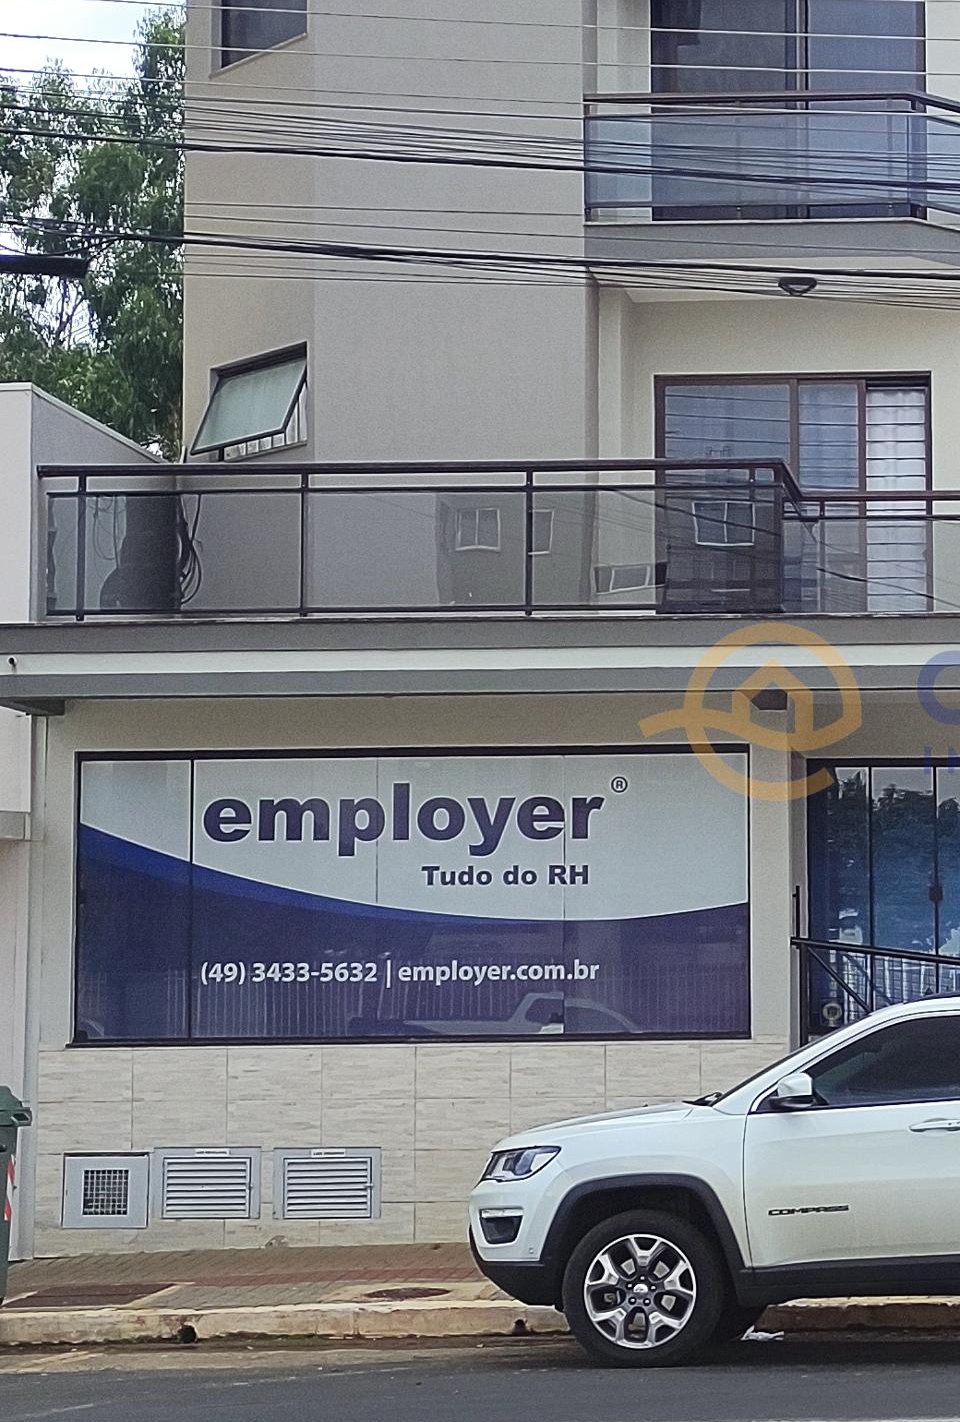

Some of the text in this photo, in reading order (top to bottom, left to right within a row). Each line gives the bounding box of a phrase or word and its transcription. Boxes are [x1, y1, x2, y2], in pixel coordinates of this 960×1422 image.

[203, 782, 605, 857] employer
[421, 864, 590, 886] Tudo do RH
[200, 962, 246, 986] (49)
[252, 961, 378, 983] 3433-5632
[398, 959, 600, 986] employer.com.br
[768, 1204, 849, 1216] COMPASS
